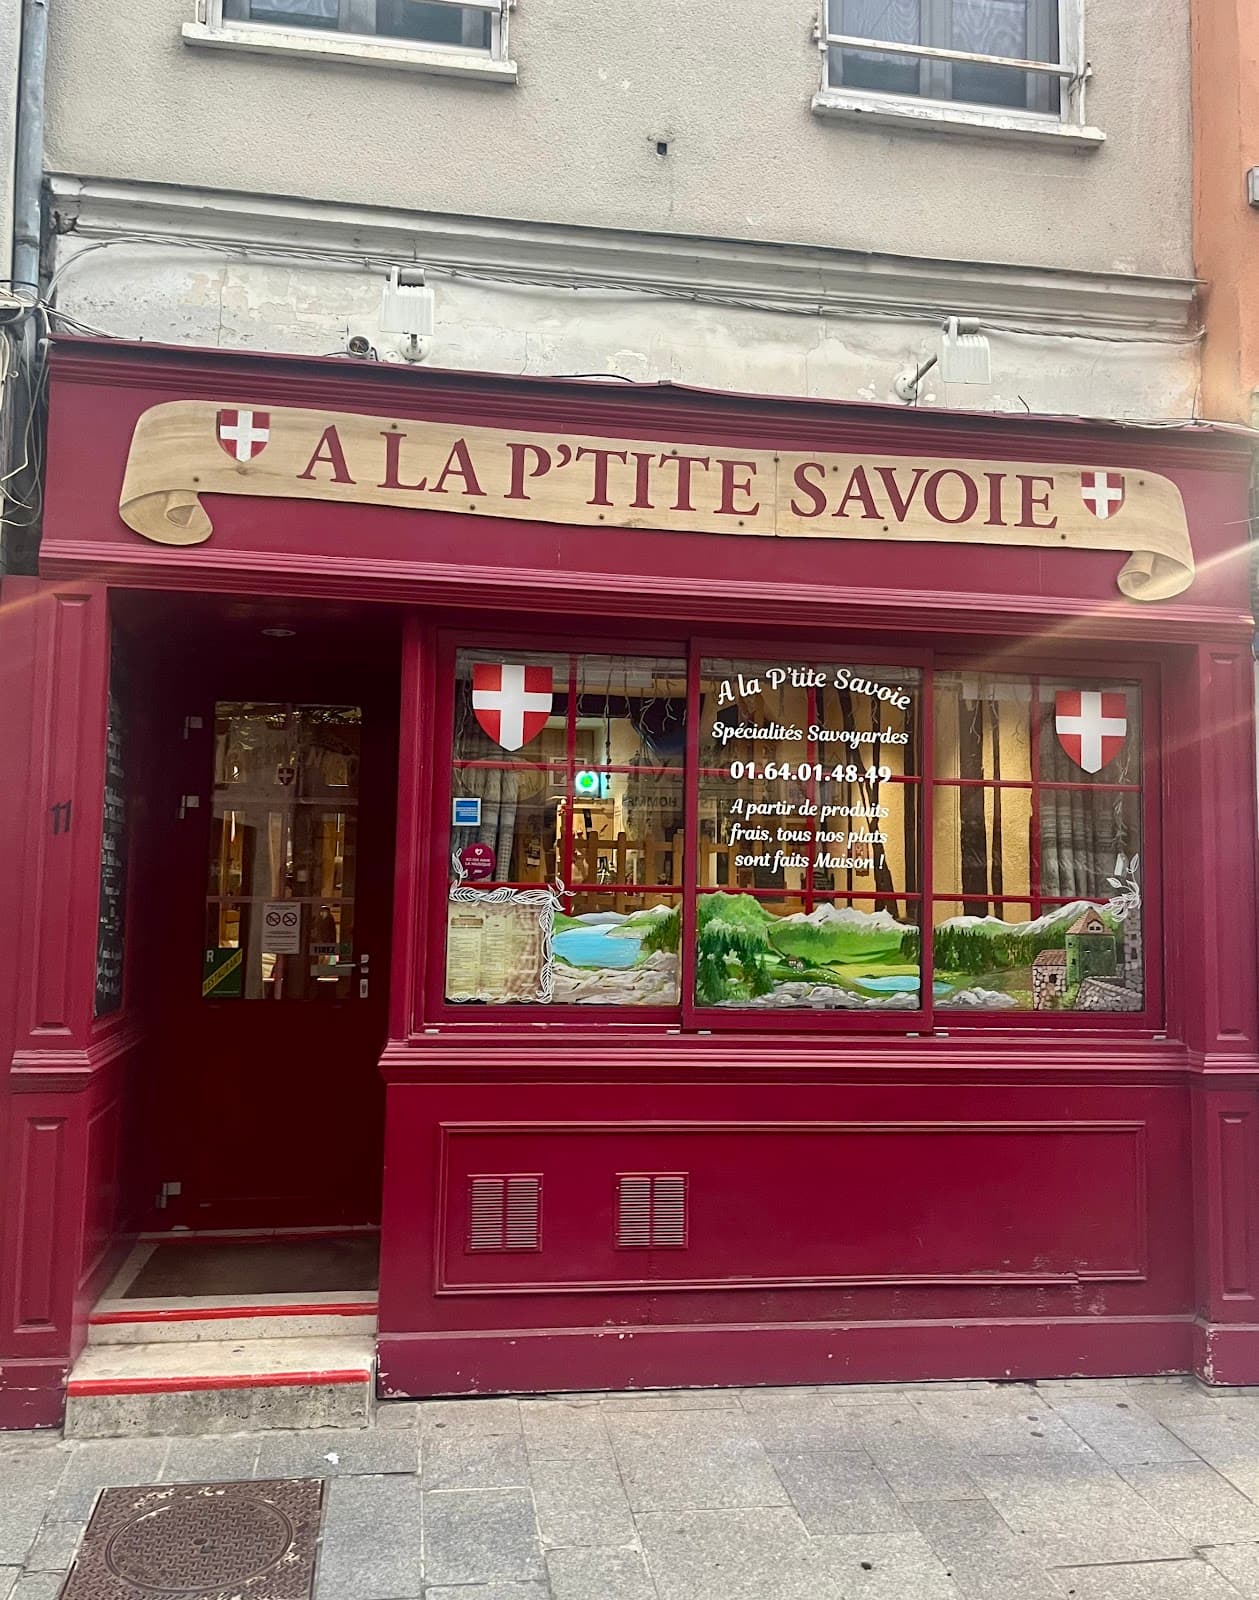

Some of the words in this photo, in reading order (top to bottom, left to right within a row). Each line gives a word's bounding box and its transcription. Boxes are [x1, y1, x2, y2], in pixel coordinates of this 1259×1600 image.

[296, 424, 357, 485] A
[376, 431, 488, 497] LA
[503, 442, 760, 515] P'TITE
[790, 462, 1058, 529] SAVOIE
[717, 680, 735, 706] A
[737, 673, 762, 697] la
[765, 667, 827, 690] P'tite
[833, 668, 911, 710] Savoie
[711, 721, 803, 746] Spécialités
[807, 725, 910, 750] Savoyardes
[730, 760, 892, 786] 01.64.01.48.49
[49, 800, 72, 835] 11
[729, 798, 743, 815] A
[745, 800, 796, 821] partir
[798, 798, 818, 816] de
[820, 800, 889, 823] produits
[728, 822, 773, 847] frais,
[776, 827, 812, 842] tous
[815, 830, 845, 843] nos
[847, 826, 889, 850] plats
[734, 853, 771, 867] sont
[771, 849, 810, 874] faits
[812, 852, 876, 870] Maison
